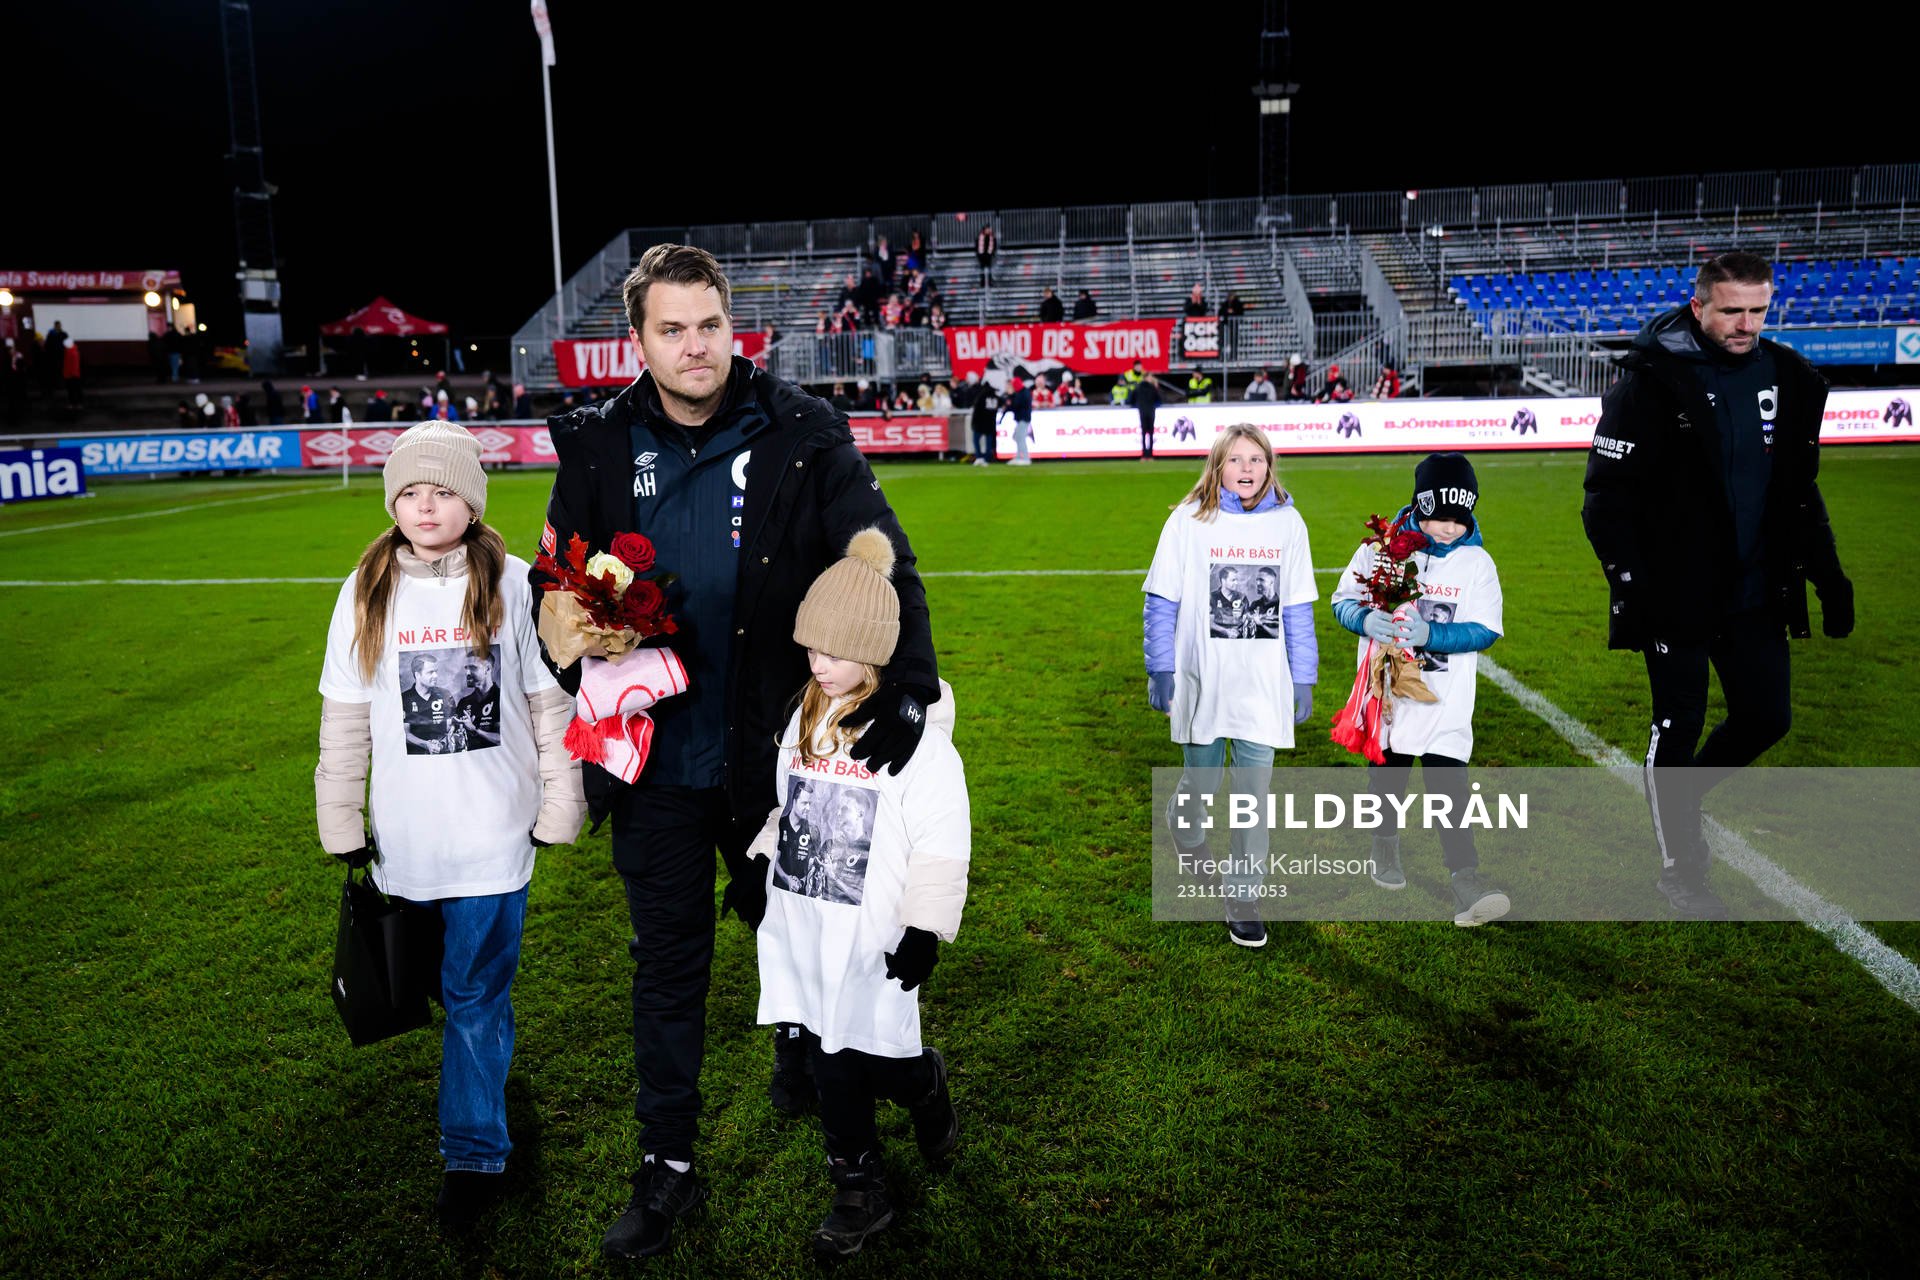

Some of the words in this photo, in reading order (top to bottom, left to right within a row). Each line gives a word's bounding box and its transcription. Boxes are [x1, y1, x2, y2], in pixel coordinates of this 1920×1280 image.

[27, 271, 95, 289] Sveriges
[101, 272, 124, 289] lag
[1042, 329, 1074, 358] DE
[82, 434, 283, 465] SWEDSKÄR
[1593, 434, 1635, 455] UNIBET
[633, 471, 657, 498] AH
[1439, 487, 1477, 511] TOBBE
[1210, 547, 1223, 558] NI
[1227, 545, 1245, 558] ÄR
[1249, 547, 1281, 559] BÄST
[398, 630, 415, 645] NI
[421, 626, 447, 643] ÄR
[907, 705, 921, 723] AH
